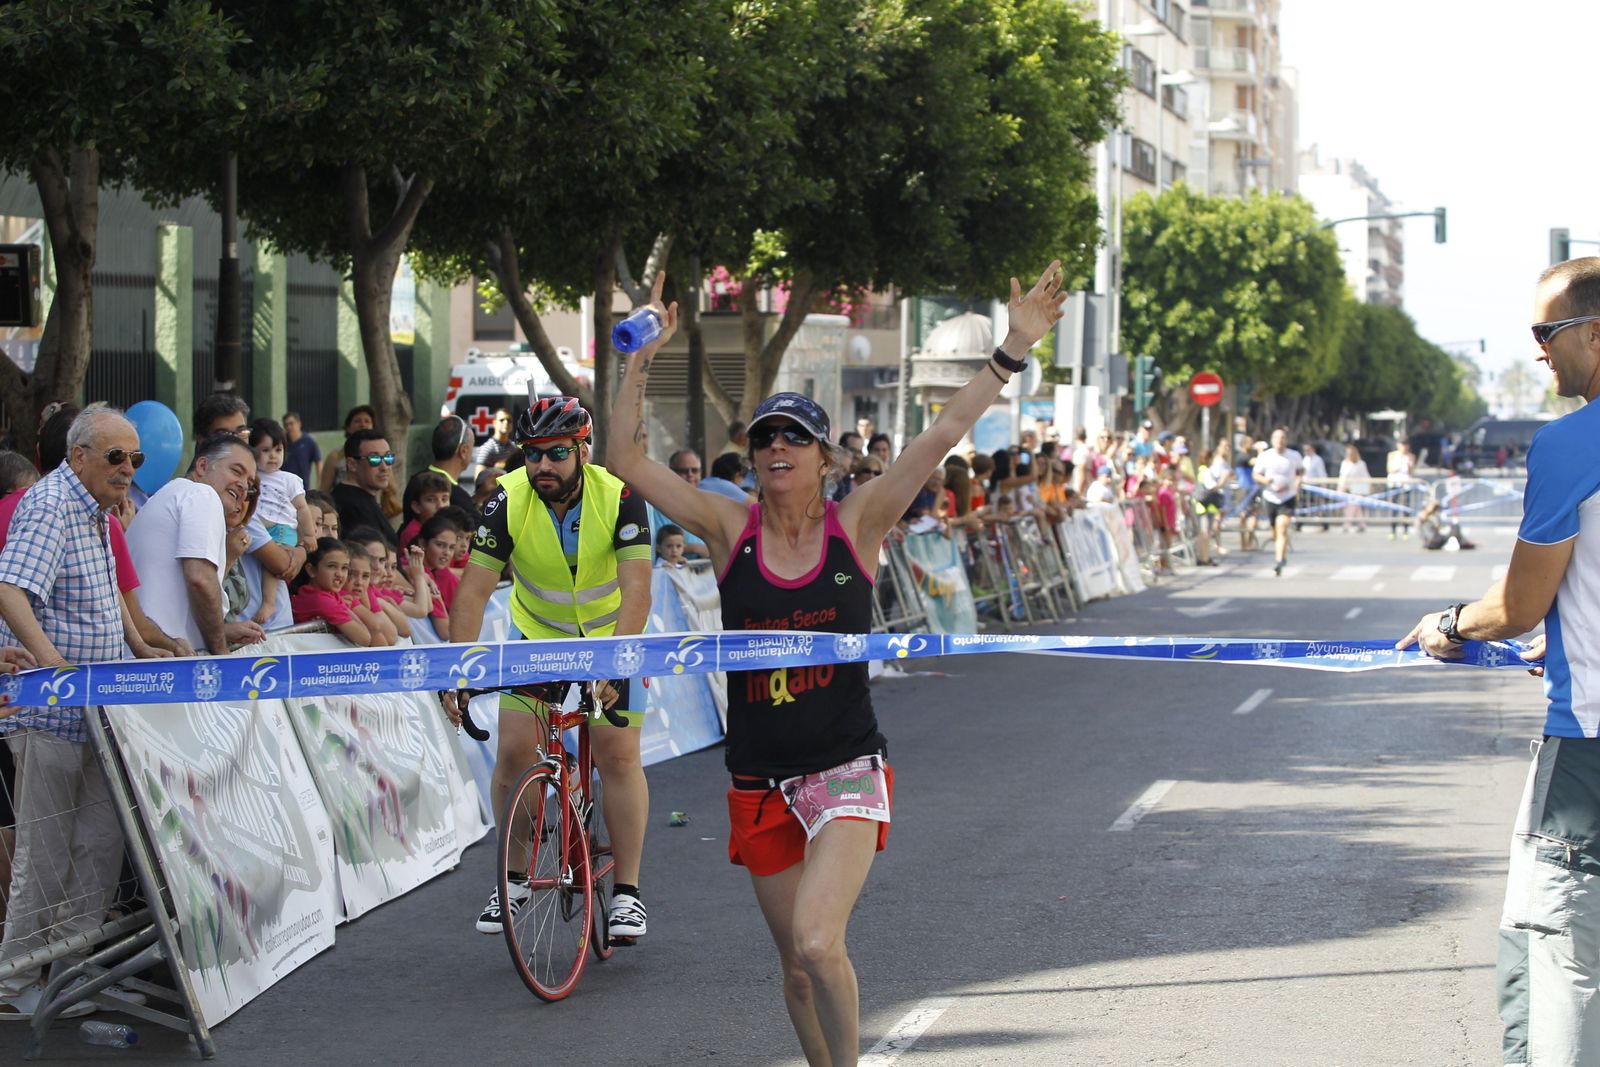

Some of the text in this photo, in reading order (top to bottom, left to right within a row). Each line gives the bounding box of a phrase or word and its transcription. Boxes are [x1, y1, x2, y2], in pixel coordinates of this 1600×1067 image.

[793, 607, 837, 628] Secos
[798, 636, 813, 646] de
[578, 651, 594, 661] de
[729, 645, 813, 660] Ayuntamiento
[365, 663, 380, 673] de
[511, 660, 593, 674] Ayuntamiento
[160, 672, 174, 682] de
[300, 672, 380, 686] Ayuntamiento
[98, 681, 174, 695] Ayuntamiento
[827, 774, 875, 796] 560
[840, 793, 861, 801] ALICIA
